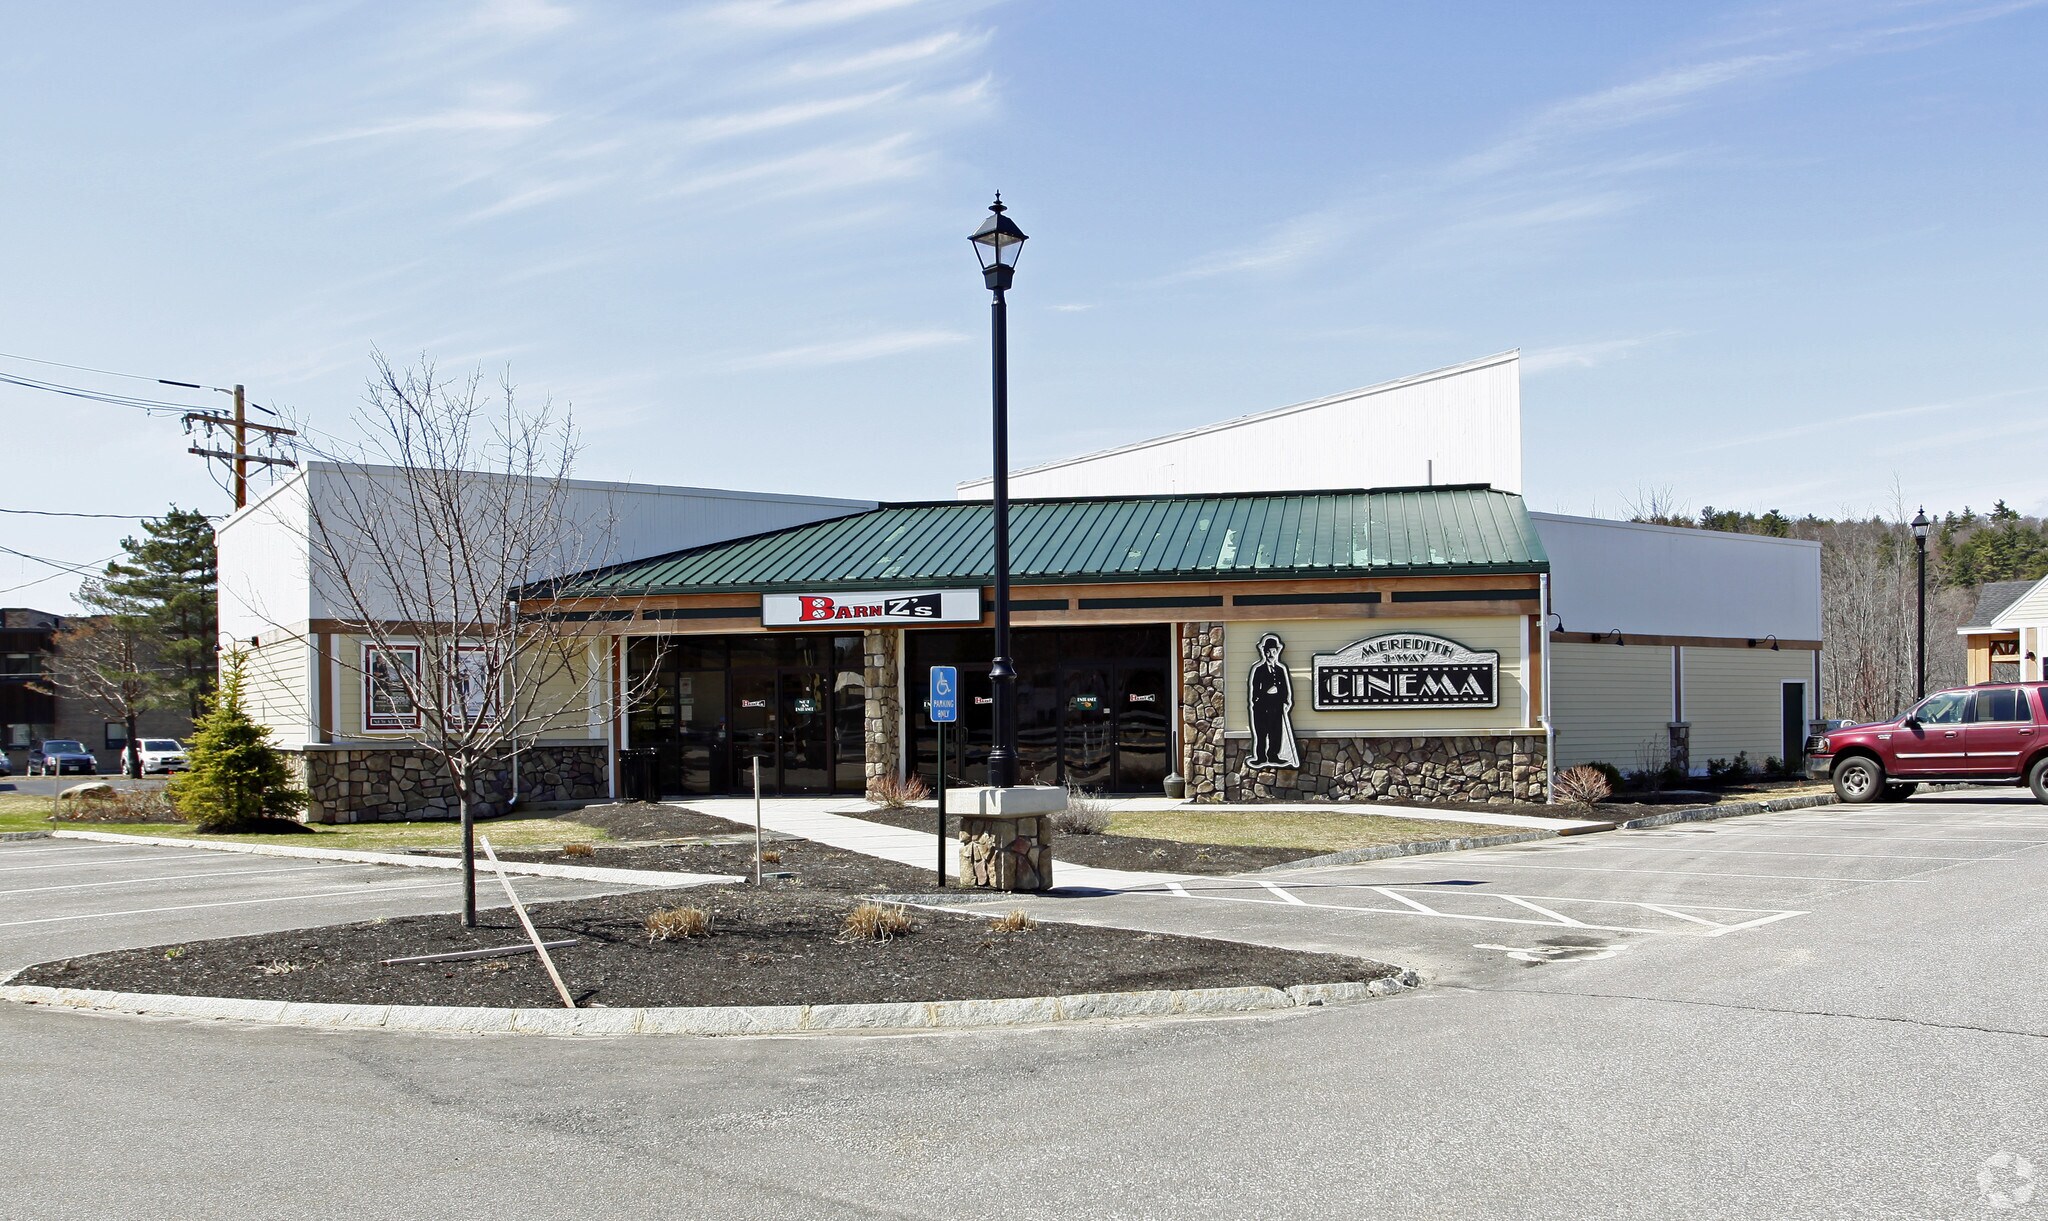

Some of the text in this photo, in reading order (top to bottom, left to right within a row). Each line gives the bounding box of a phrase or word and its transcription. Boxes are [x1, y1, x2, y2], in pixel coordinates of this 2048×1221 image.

[1361, 638, 1455, 659] MEREDITH
[1325, 672, 1485, 698] CINEMA
[933, 699, 954, 708] PARKING
[937, 709, 950, 718] ONLY
